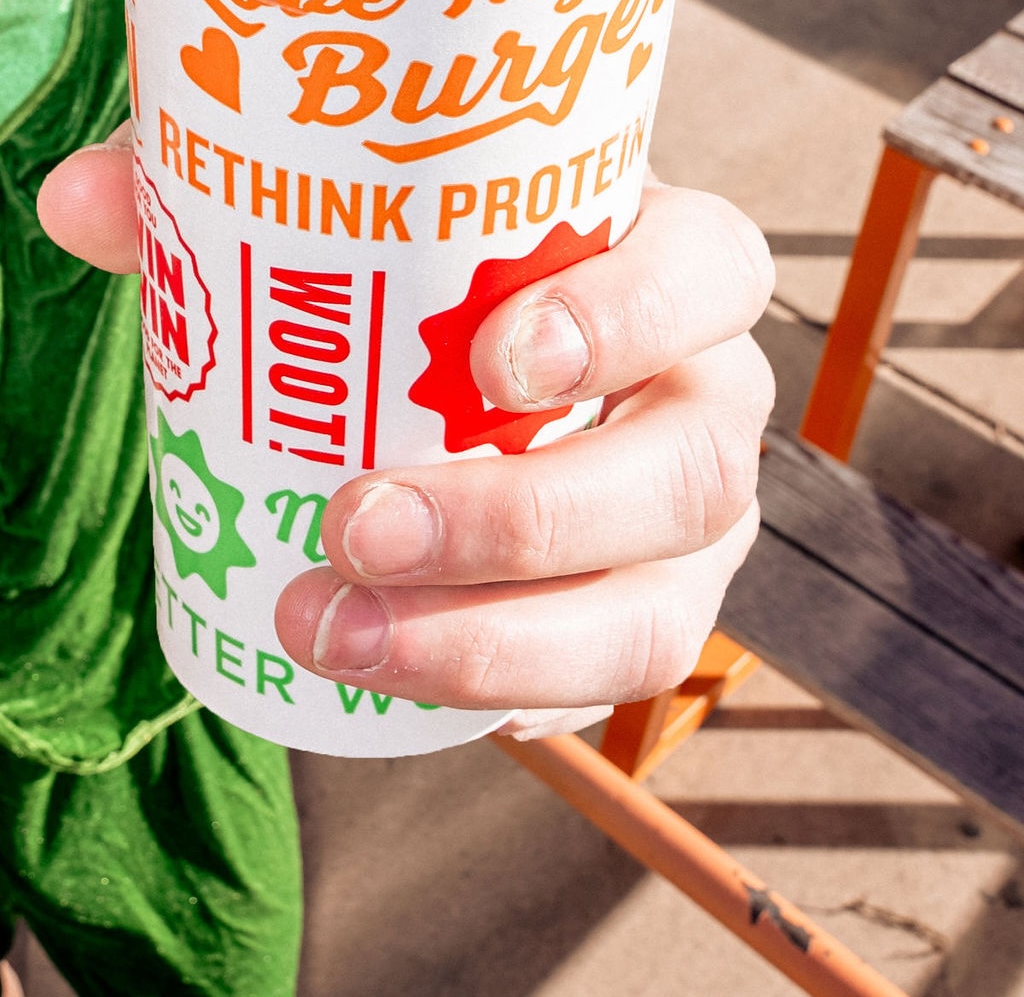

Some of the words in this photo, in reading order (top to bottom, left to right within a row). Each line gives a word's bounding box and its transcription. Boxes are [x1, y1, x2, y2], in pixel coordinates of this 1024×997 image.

[159, 108, 415, 241] RETHINK
[436, 99, 649, 241] PROTEIN
[268, 265, 353, 467] WOOT!
[154, 558, 296, 705] TTER
